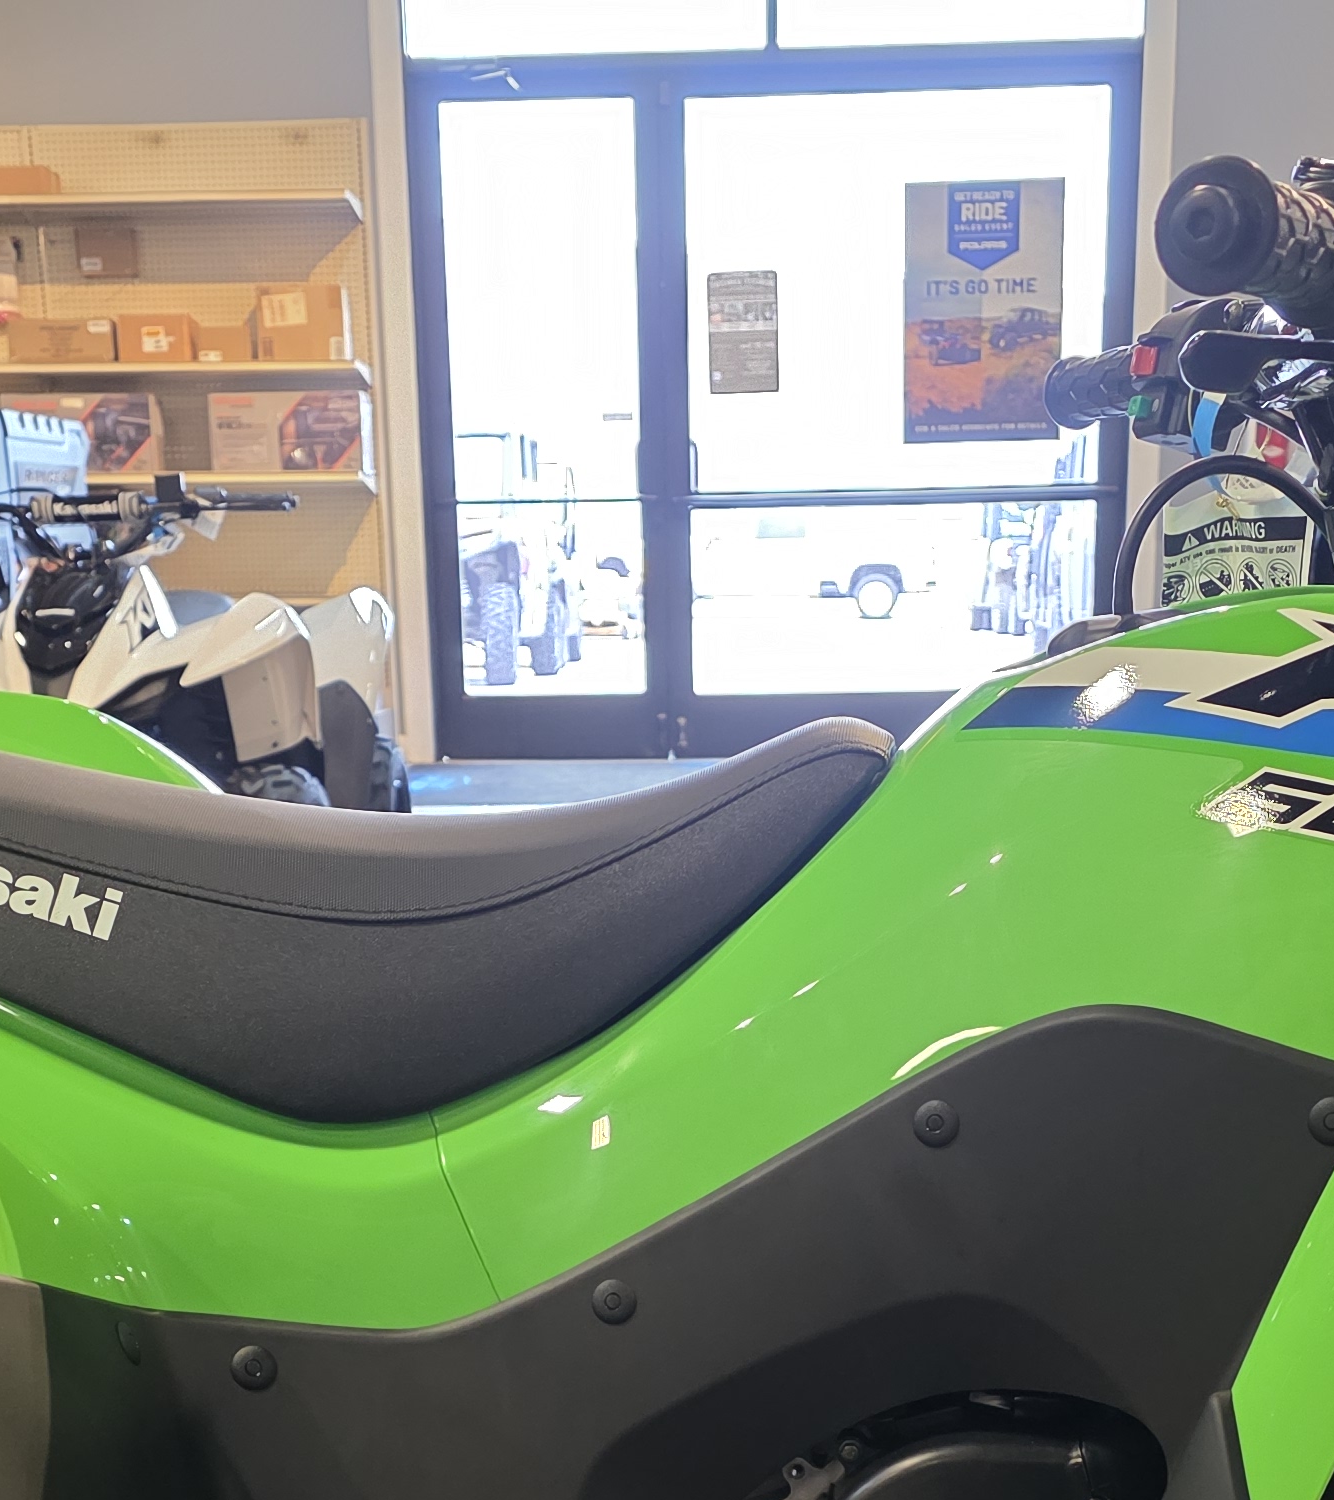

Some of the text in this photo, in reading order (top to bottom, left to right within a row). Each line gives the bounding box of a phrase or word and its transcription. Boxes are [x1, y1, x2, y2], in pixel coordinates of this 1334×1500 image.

[961, 202, 1008, 222] RIDE
[926, 277, 1037, 297] IT'S GO TIME
[1203, 520, 1266, 540] WARNING
[1276, 545, 1296, 554] DEATH
